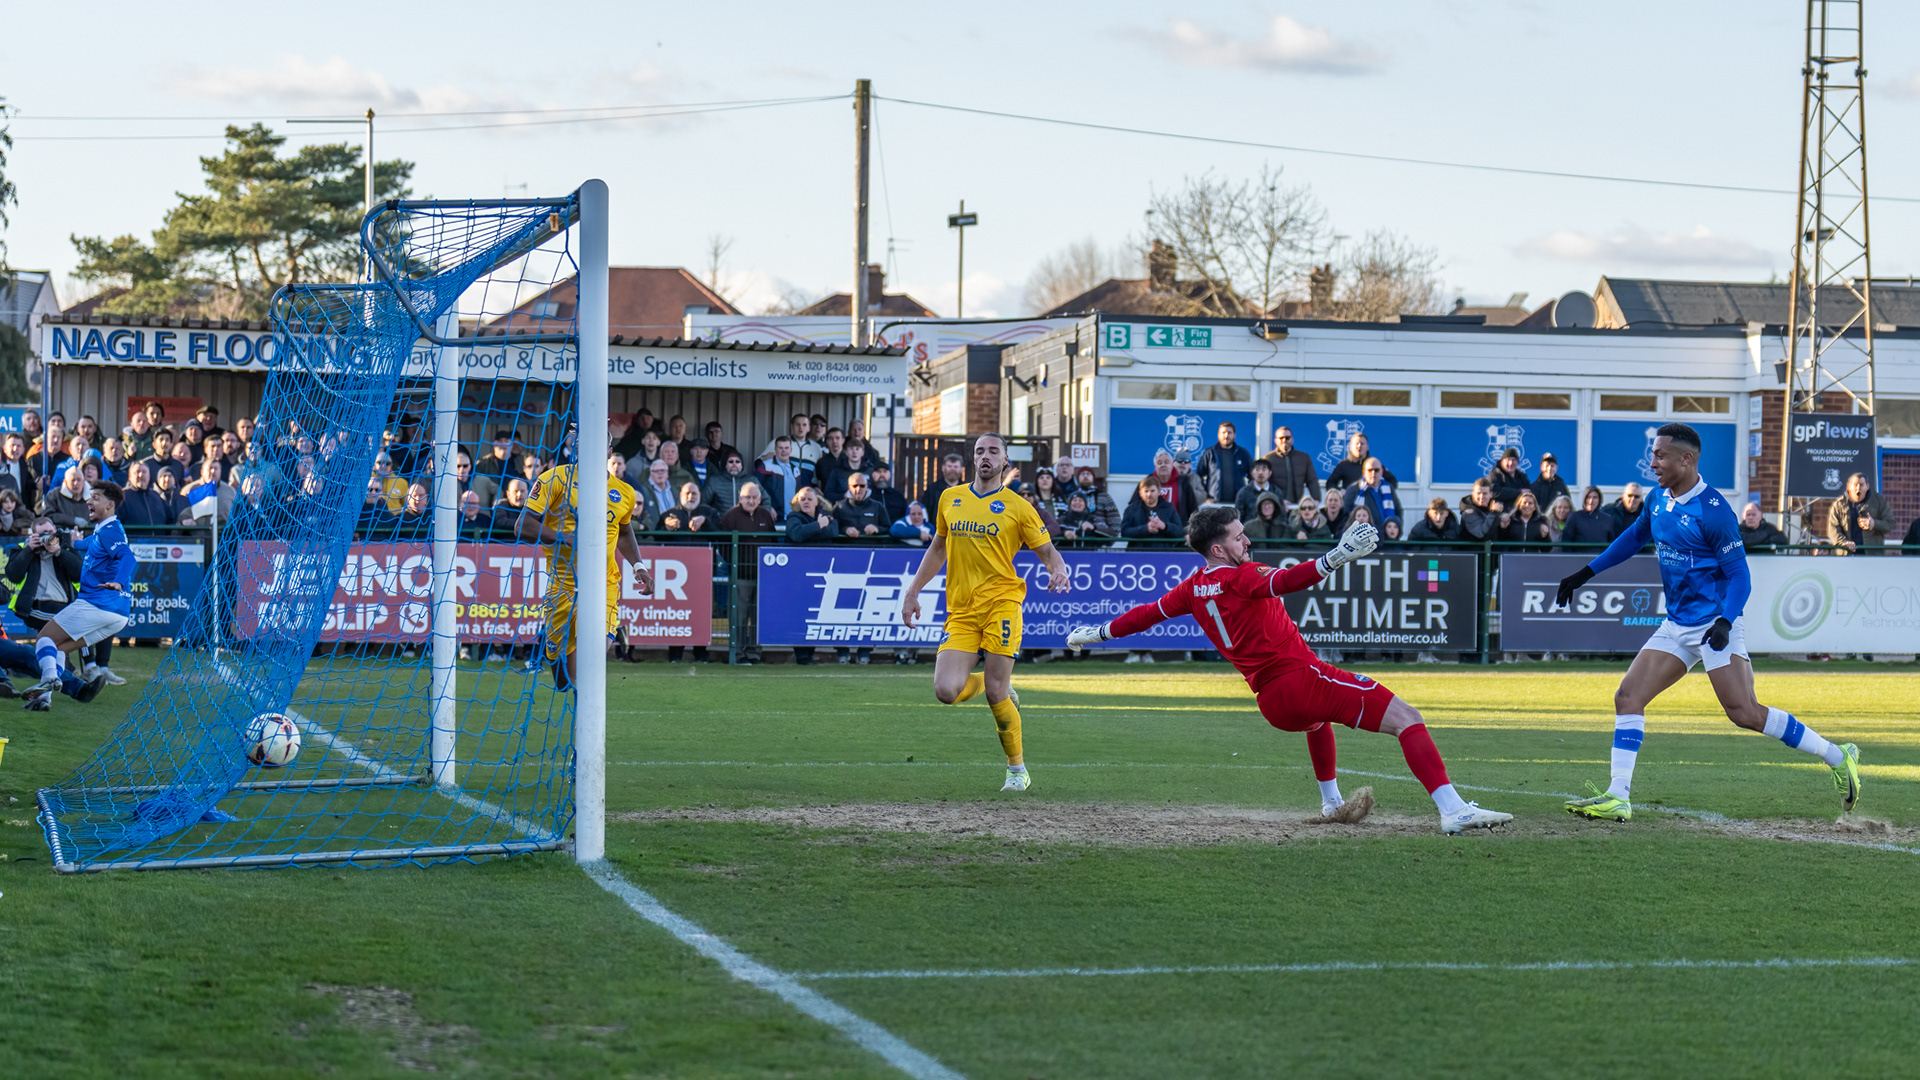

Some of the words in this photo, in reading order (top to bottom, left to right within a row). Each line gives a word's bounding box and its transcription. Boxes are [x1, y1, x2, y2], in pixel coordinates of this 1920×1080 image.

[1109, 326, 1127, 347] B
[1191, 328, 1208, 337] Fire
[52, 327, 177, 363] NAGLE
[1190, 338, 1208, 347] exit
[517, 350, 532, 370] &
[644, 355, 748, 380] Specialists
[787, 361, 801, 371] Tel:
[805, 361, 823, 371] 020
[826, 362, 849, 372] 8424
[852, 363, 877, 373] 0800
[767, 371, 895, 385] www.nagleflooring.co.uk
[1073, 447, 1098, 459] EXIT
[950, 520, 986, 534] utilita
[1099, 564, 1157, 591] 538
[156, 595, 190, 612] goals,
[138, 616, 145, 624] a
[148, 611, 170, 624] ball
[642, 606, 691, 620] timber
[471, 624, 481, 634] a
[483, 620, 514, 636] fast,
[629, 623, 692, 637] business
[1001, 620, 1011, 639] 5
[1205, 599, 1233, 649] 1
[805, 625, 943, 642] SCAFFOLDING
[1300, 631, 1447, 644] w.smithandlatimer.co.uk
